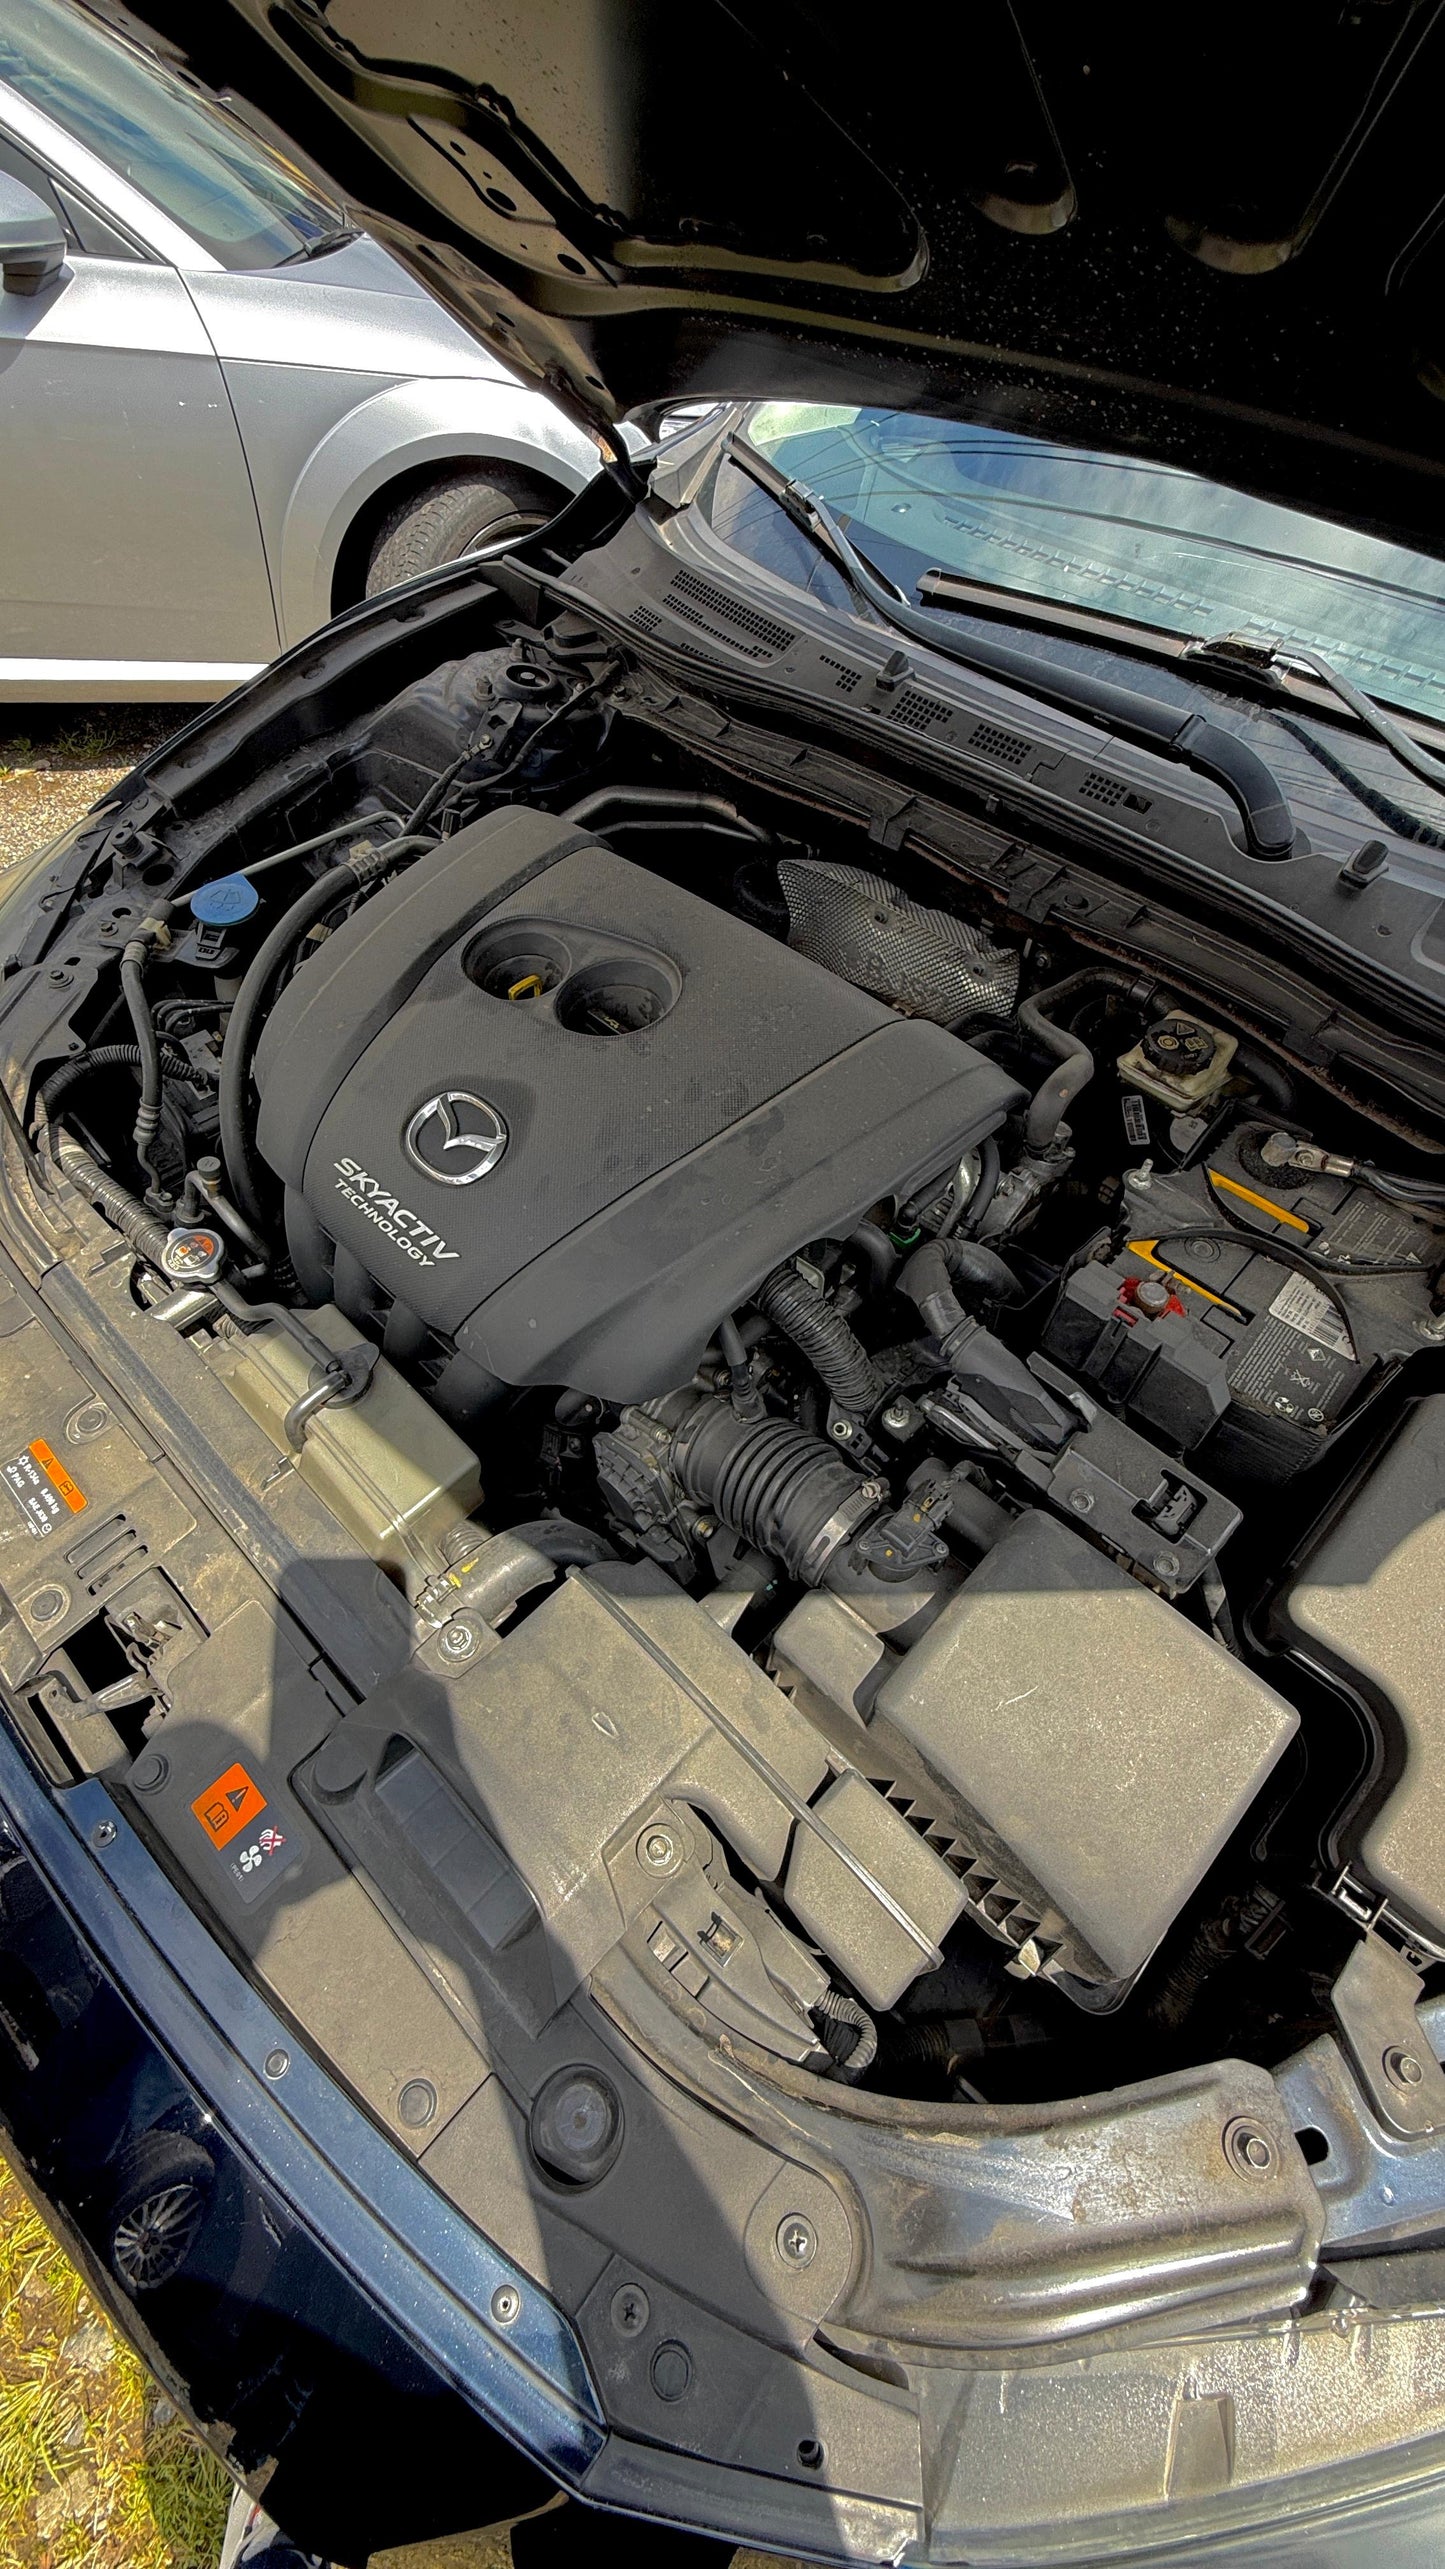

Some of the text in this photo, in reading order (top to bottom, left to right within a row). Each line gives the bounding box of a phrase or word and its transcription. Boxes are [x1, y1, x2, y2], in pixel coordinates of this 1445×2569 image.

[333, 1157, 461, 1260] SKYACTIV
[334, 1178, 436, 1268] TECHNOLOGY
[11, 1473, 25, 1488] PAG
